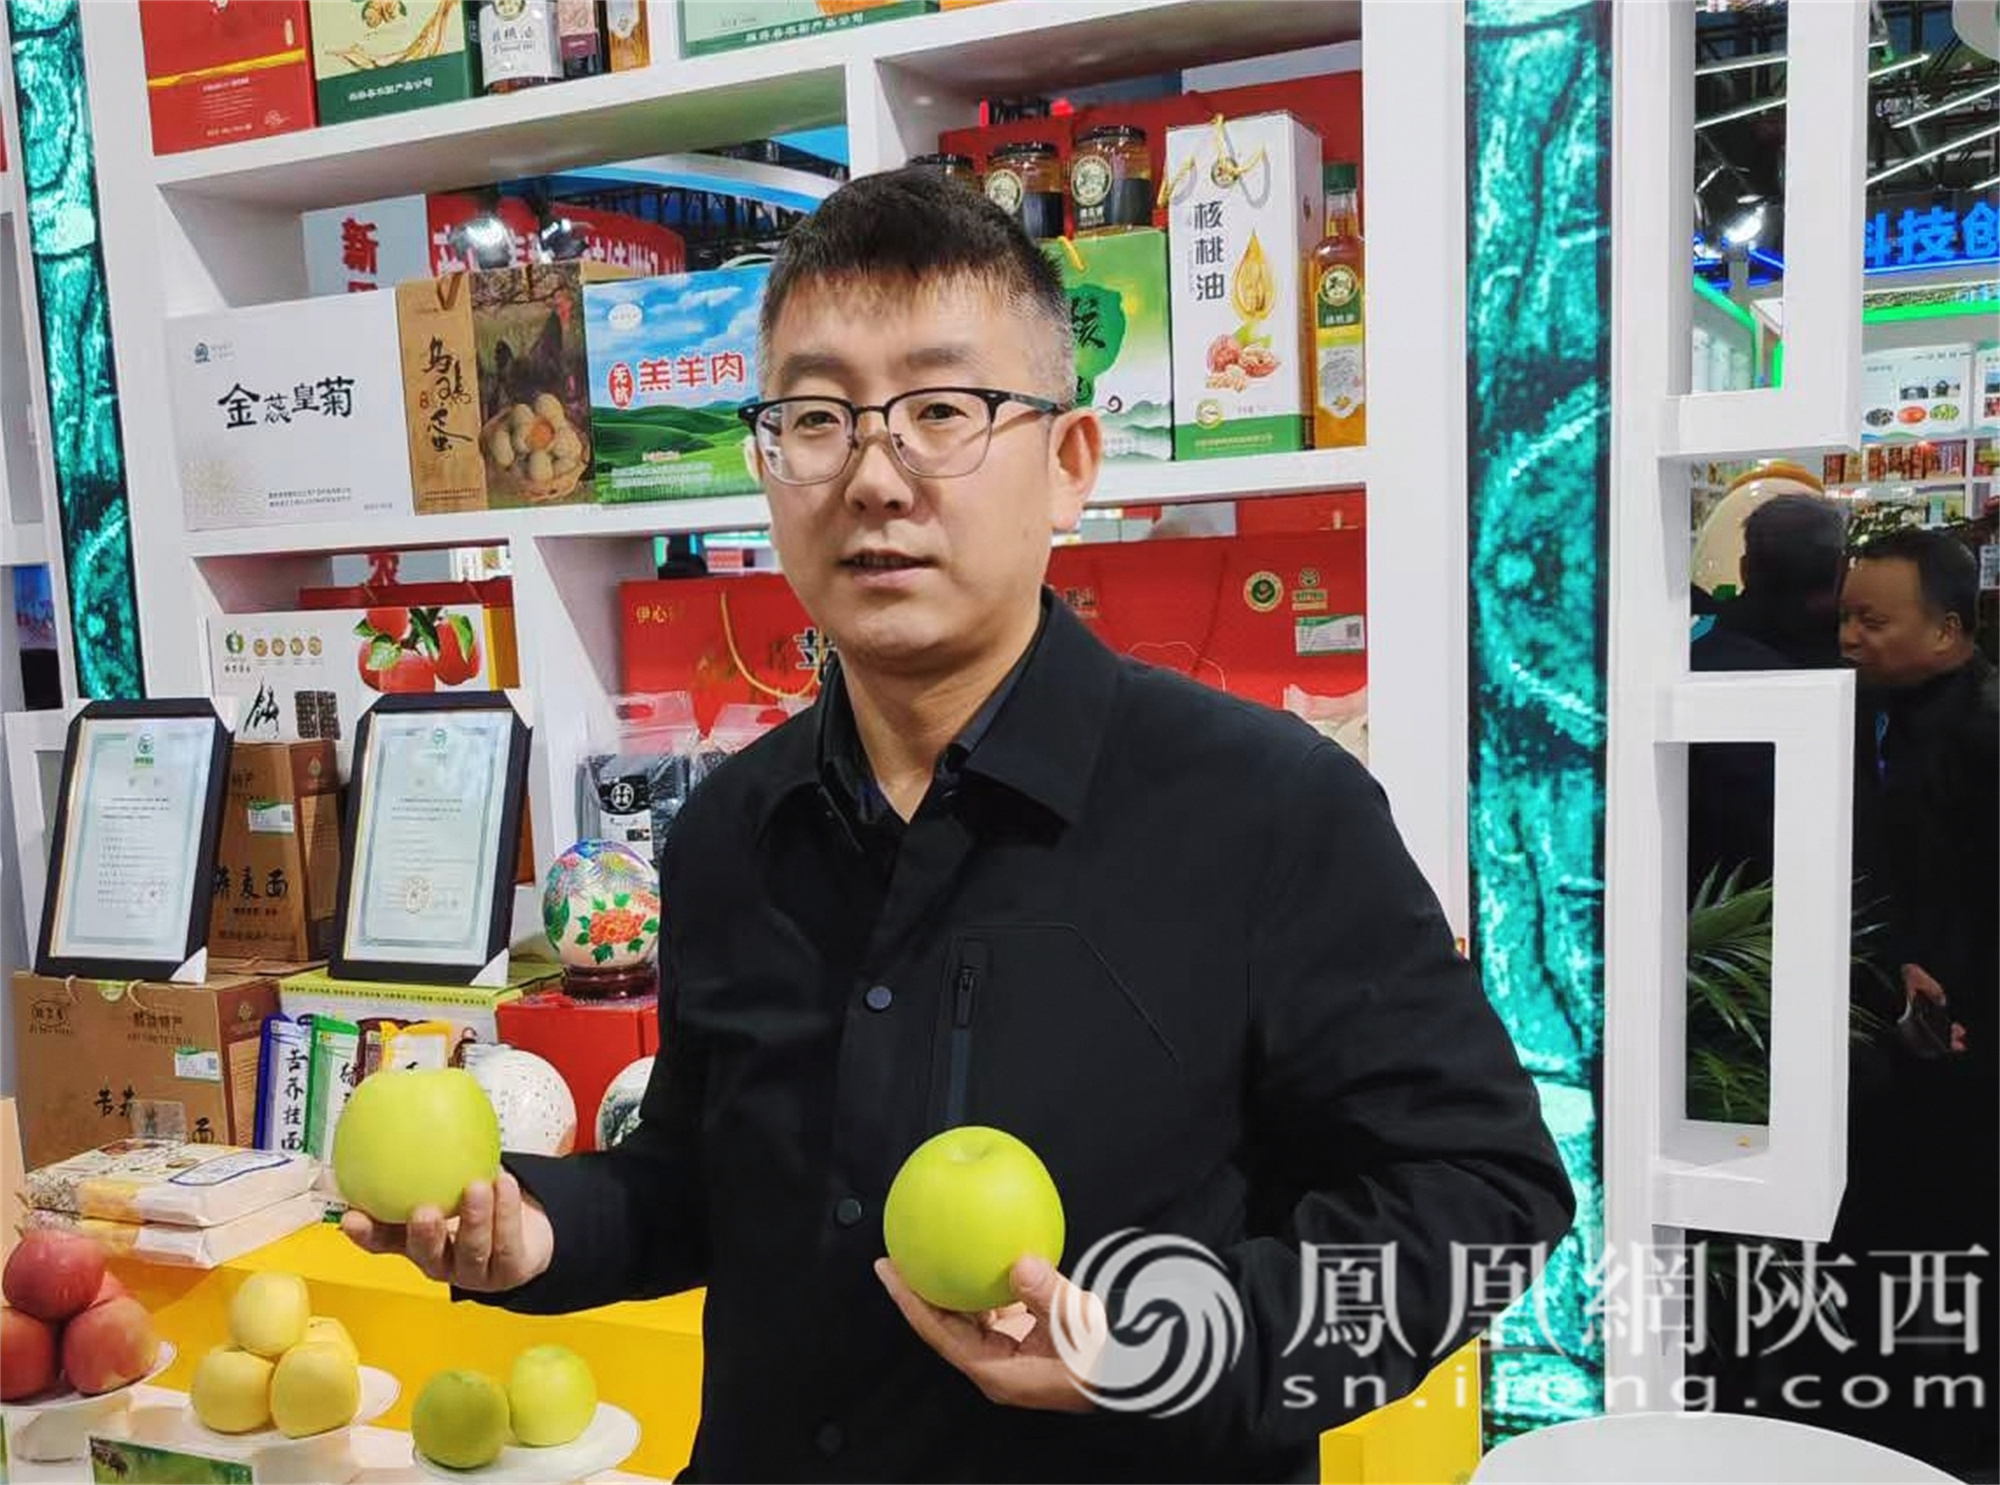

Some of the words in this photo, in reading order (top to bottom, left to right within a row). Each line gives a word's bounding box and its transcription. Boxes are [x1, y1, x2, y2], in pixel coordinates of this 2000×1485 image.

[342, 219, 379, 291] 新
[1194, 200, 1225, 301] 核桃油
[218, 376, 355, 429] 金蕊皇菊
[639, 352, 744, 392] 羔羊肉
